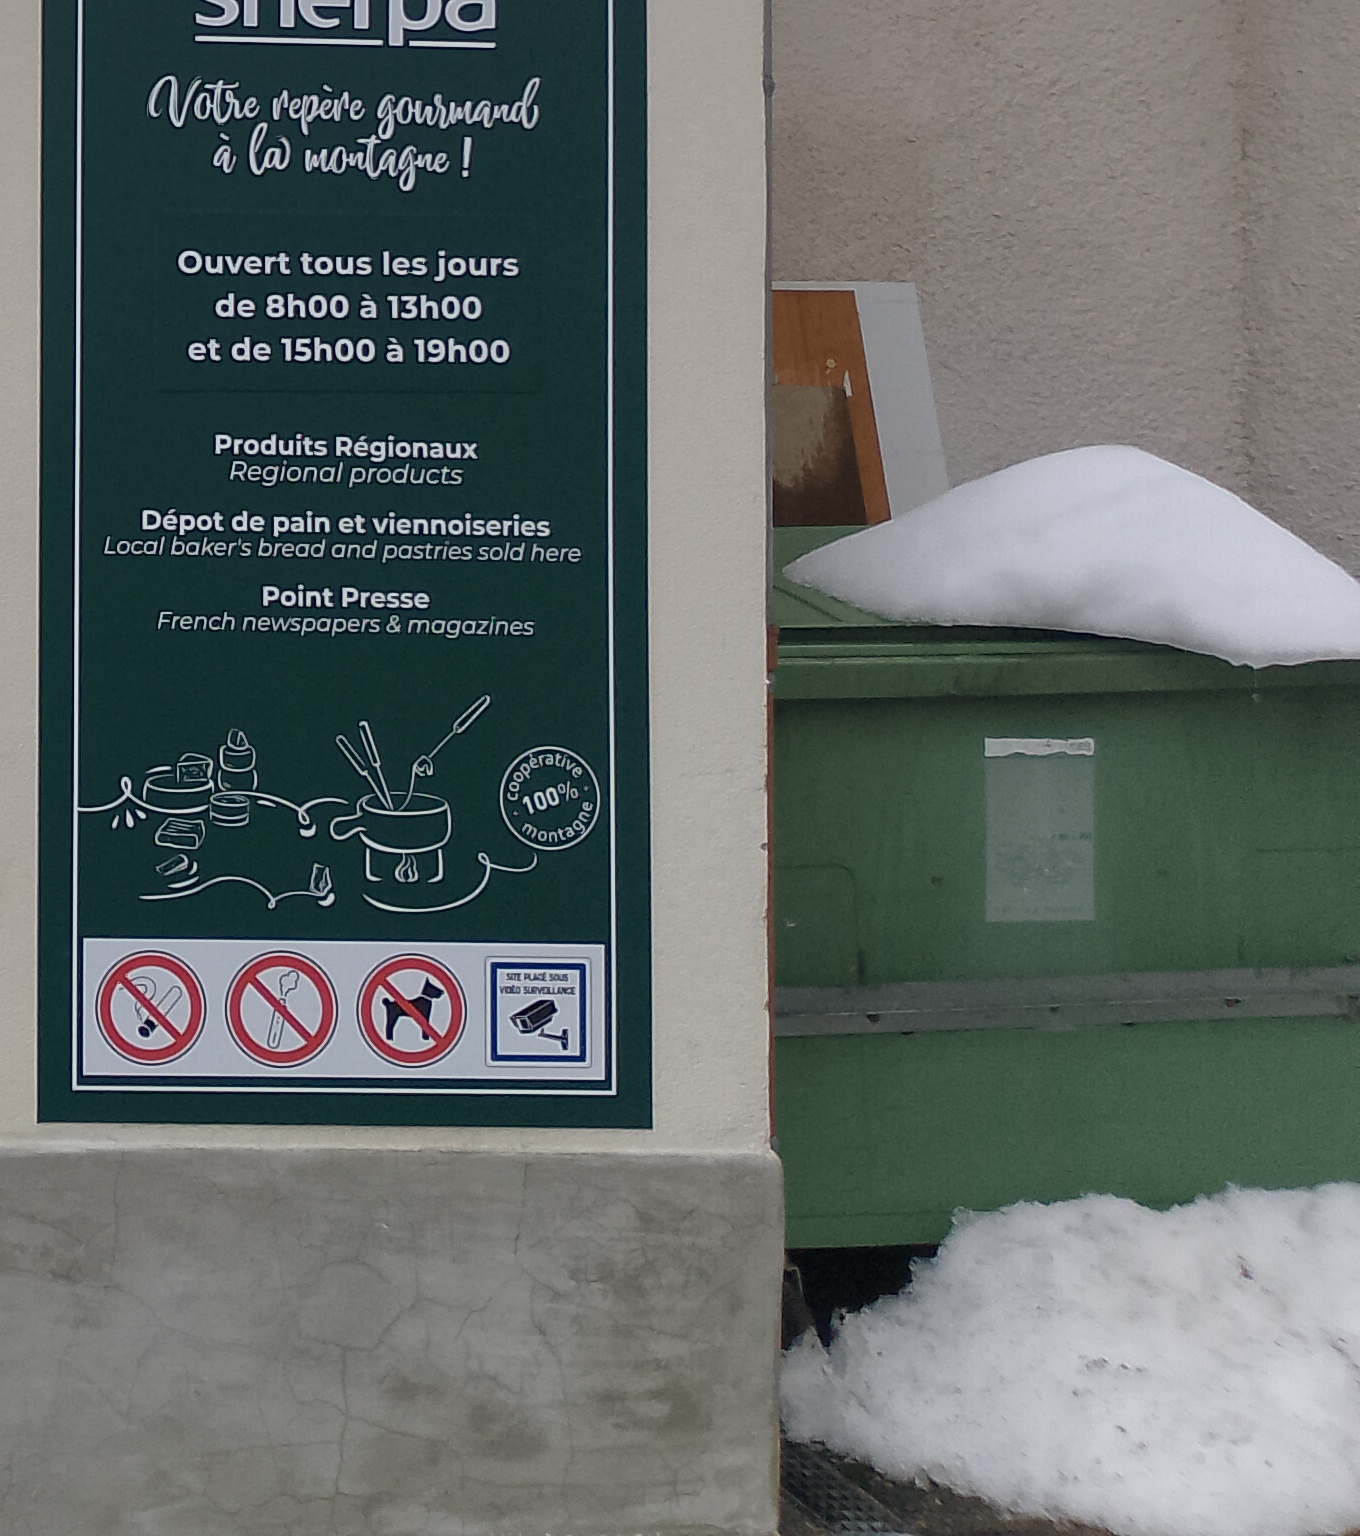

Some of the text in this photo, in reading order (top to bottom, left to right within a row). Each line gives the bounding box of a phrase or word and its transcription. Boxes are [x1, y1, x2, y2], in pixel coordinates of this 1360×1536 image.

[146, 75, 541, 140] Votre repère gourmand
[212, 121, 472, 192] à la montagne !
[177, 250, 520, 282] Ouvert tous les jours
[215, 292, 482, 320] de 8h00 à 13h00
[187, 336, 510, 364] et de 15h00 à 19h00
[214, 433, 479, 463] Produits Régionaux
[229, 459, 464, 488] Regional products
[141, 508, 551, 538] Dépot de pain et viennoiseries
[103, 535, 582, 564] Local baker's bread and pastries sold here
[262, 583, 431, 609] Point Presse
[157, 611, 535, 639] French newspapers & magazines
[507, 752, 583, 801] coopérative
[522, 780, 580, 815] 100%
[521, 801, 594, 843] montagne
[505, 972, 522, 982] SITE
